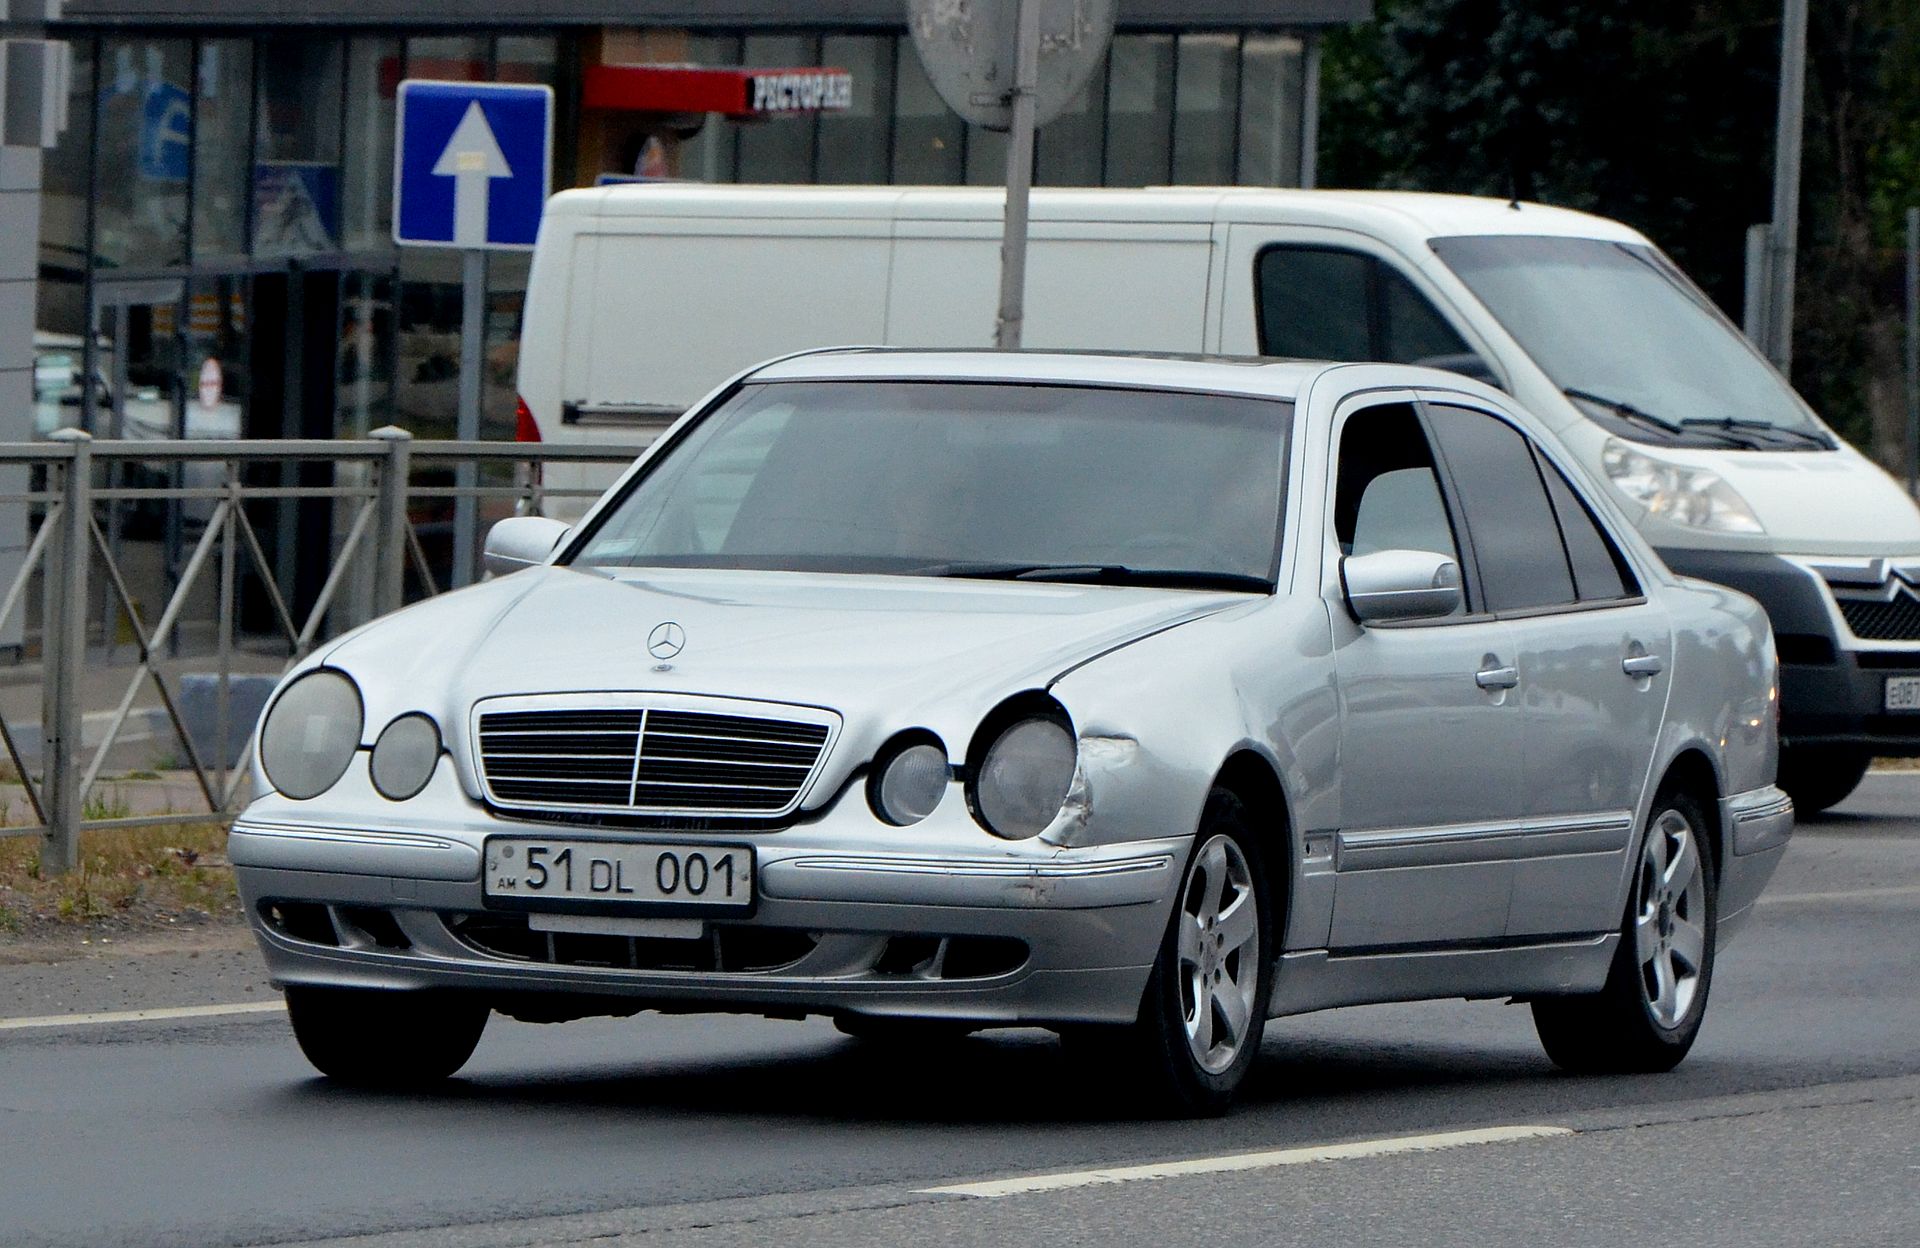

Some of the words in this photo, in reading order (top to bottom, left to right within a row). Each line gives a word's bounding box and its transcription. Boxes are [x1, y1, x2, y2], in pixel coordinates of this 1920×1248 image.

[497, 877, 516, 891] AM
[525, 846, 572, 892] 51
[589, 858, 634, 894] DL
[655, 851, 734, 897] 001
